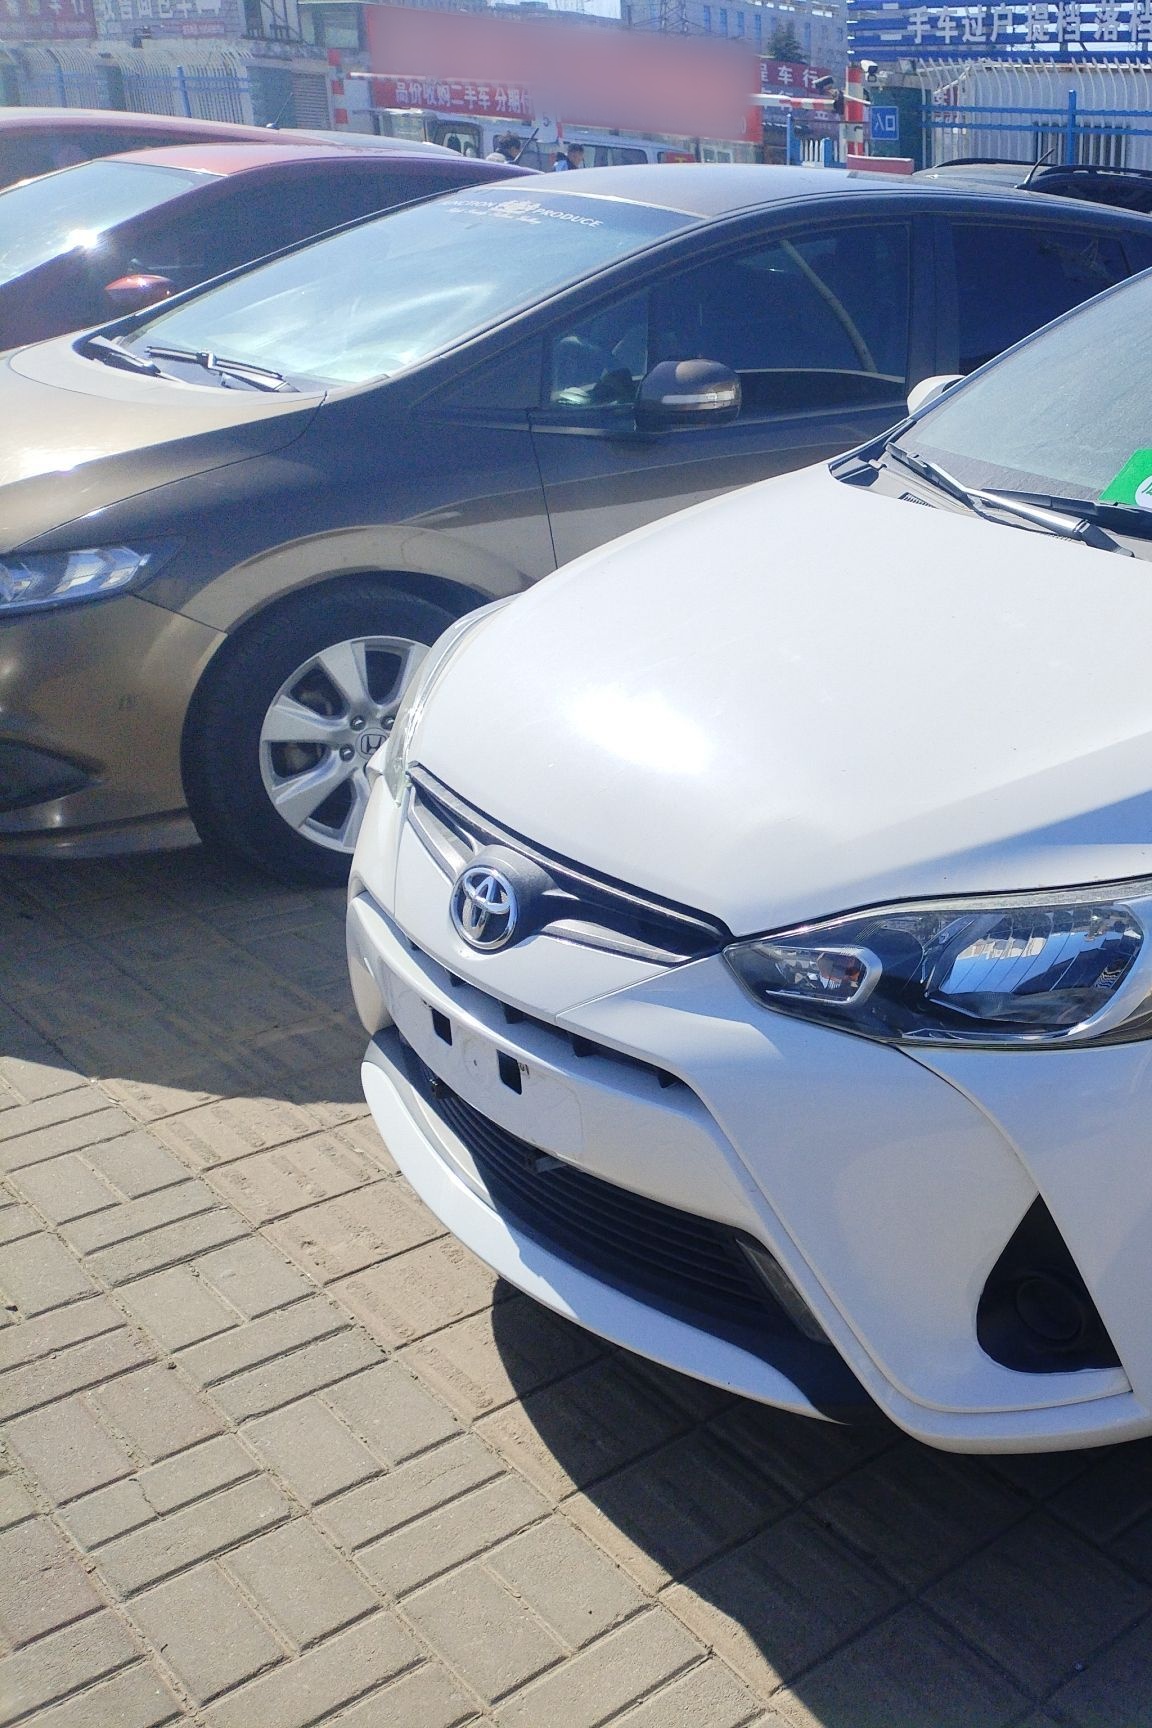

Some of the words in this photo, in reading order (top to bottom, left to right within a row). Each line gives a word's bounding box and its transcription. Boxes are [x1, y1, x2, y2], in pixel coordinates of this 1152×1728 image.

[1024, 2, 1082, 42] 提档
[874, 112, 896, 131] 入口
[532, 208, 604, 228] PRODUCE
